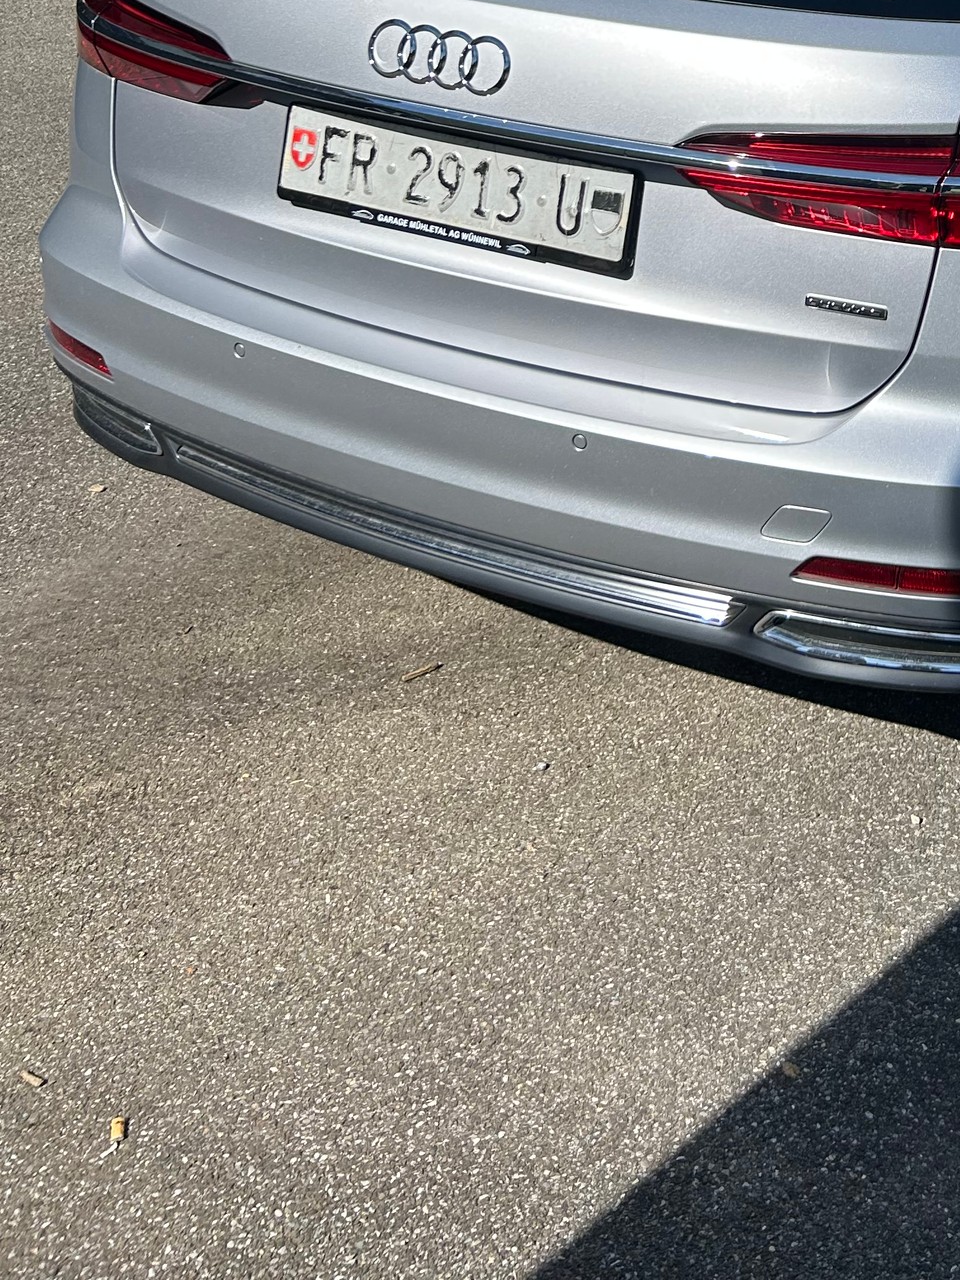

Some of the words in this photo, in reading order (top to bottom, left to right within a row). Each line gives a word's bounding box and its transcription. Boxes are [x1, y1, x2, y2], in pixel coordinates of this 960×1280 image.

[317, 125, 378, 195] FR
[403, 144, 528, 225] 2913
[555, 173, 591, 237] U
[377, 213, 409, 227] GARAGE
[409, 220, 448, 236] MÜHLETAL
[448, 229, 461, 239] AG
[461, 232, 502, 248] WÜNNEWIL
